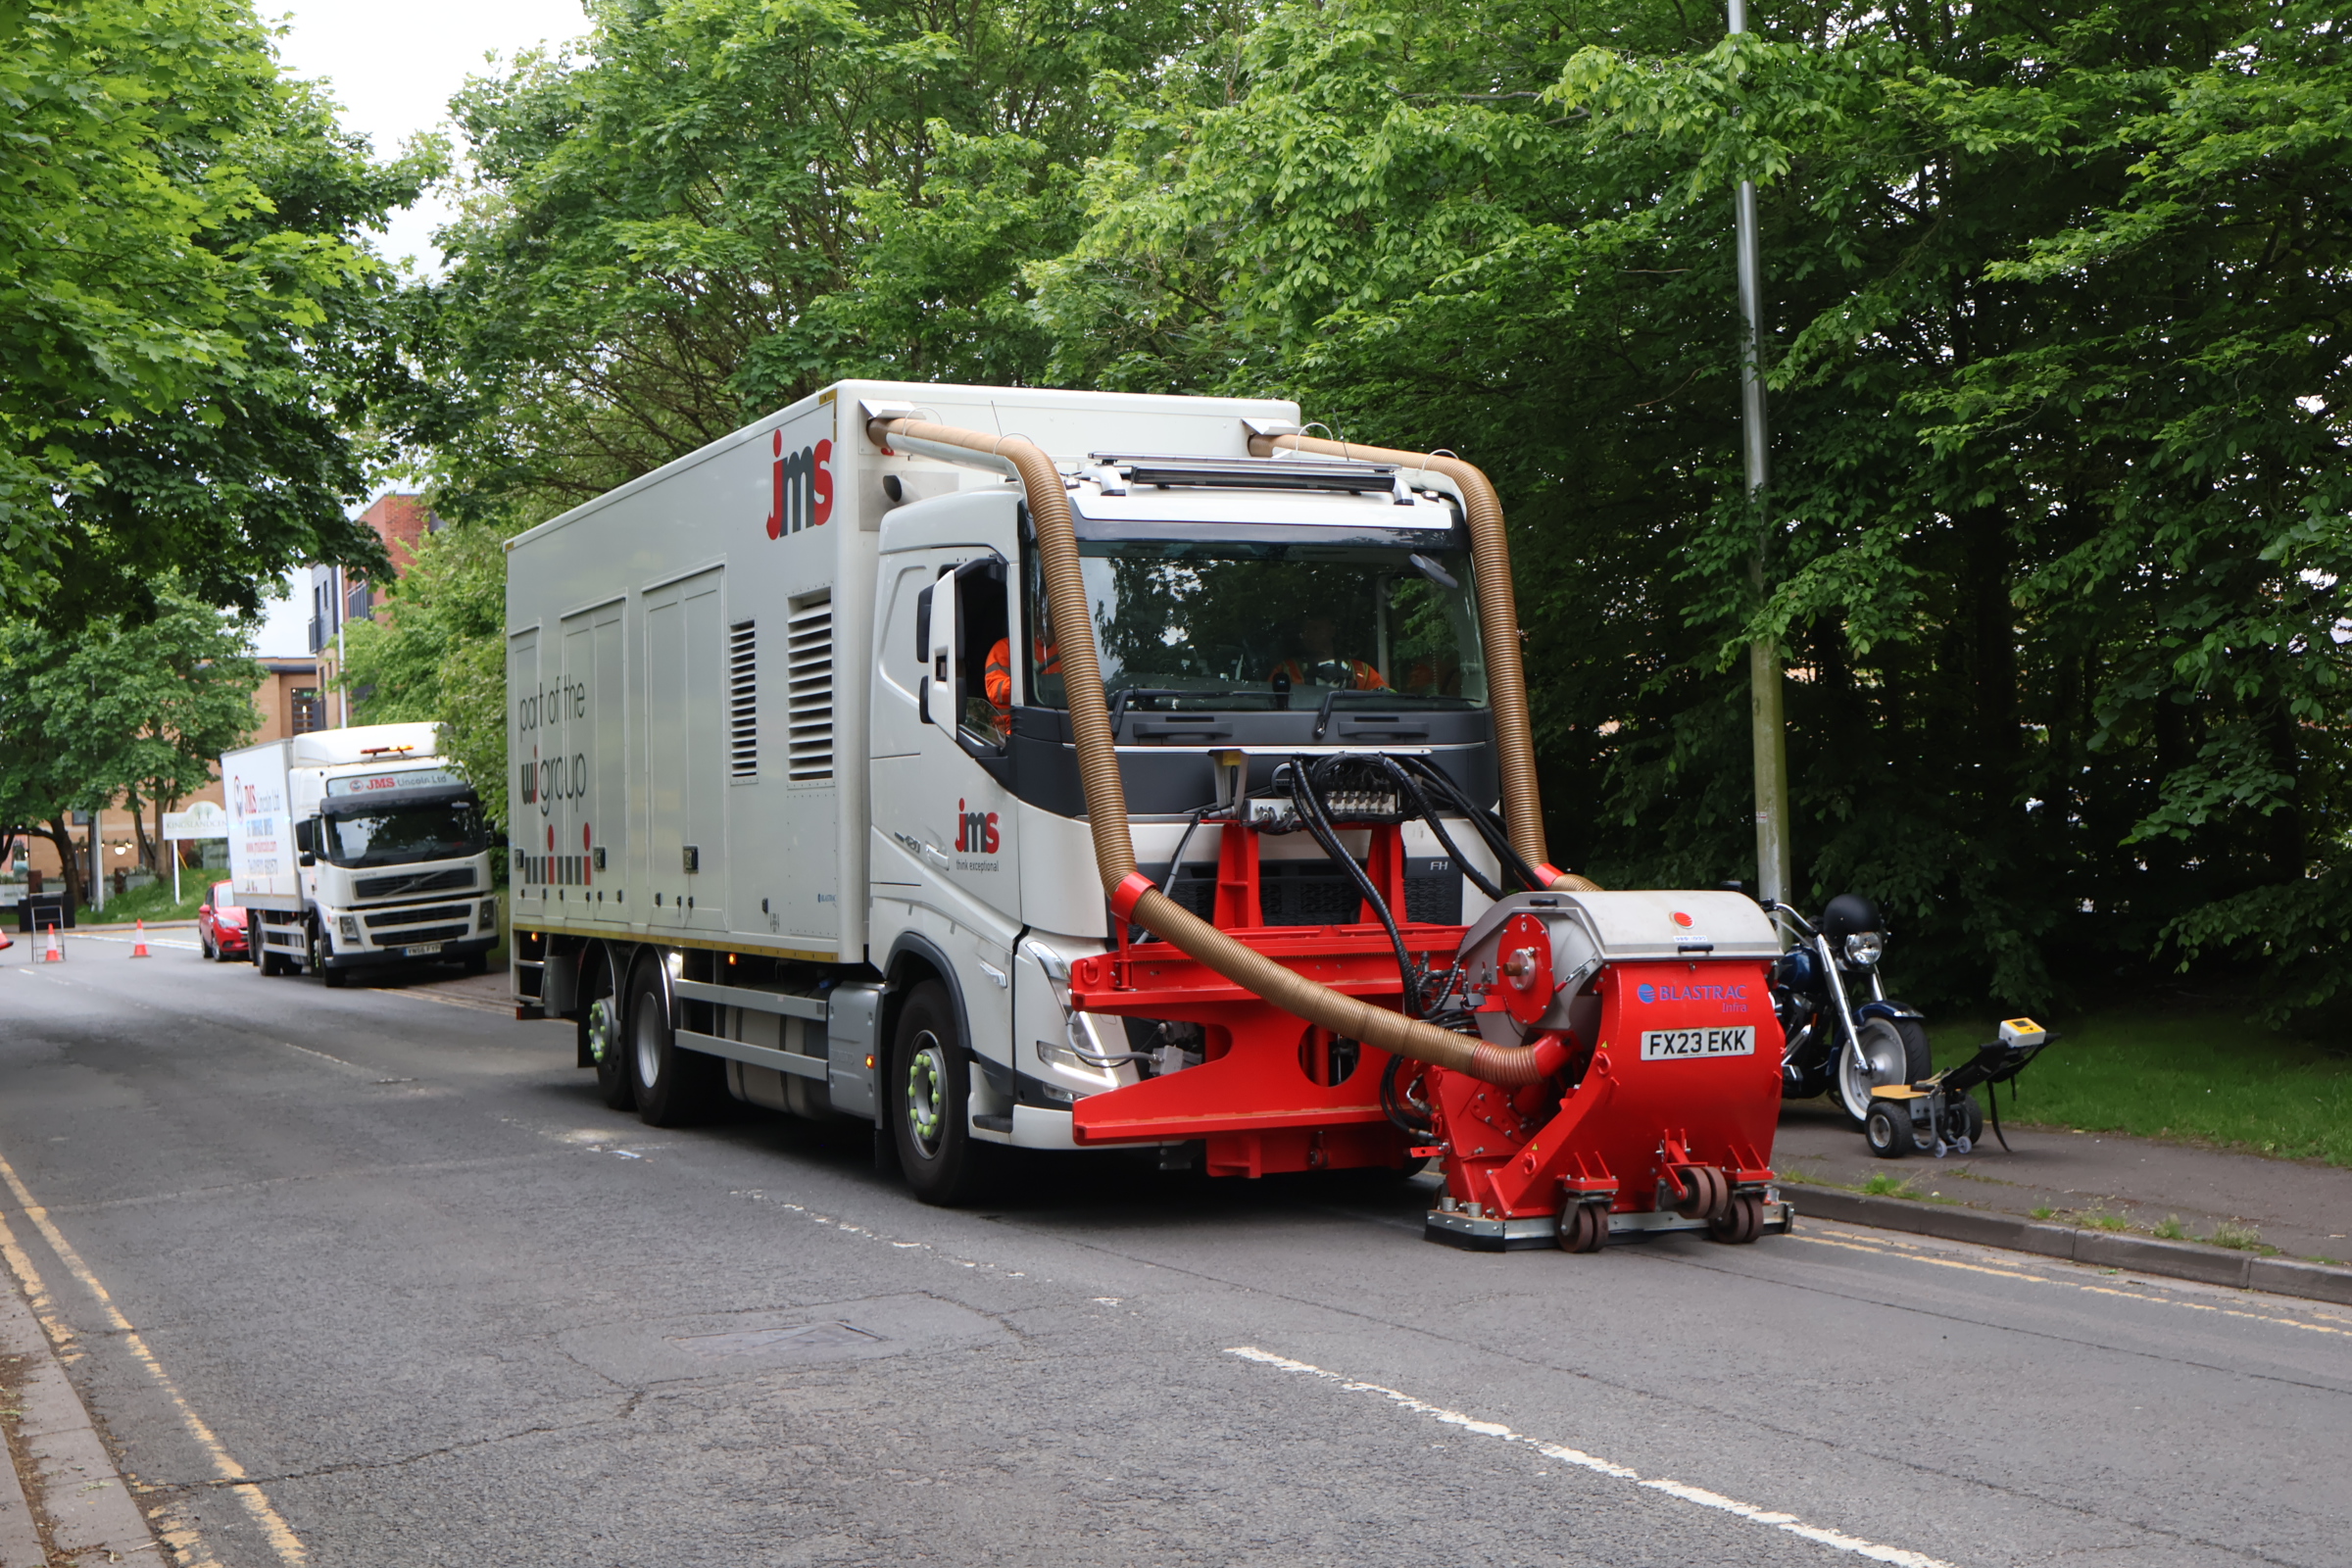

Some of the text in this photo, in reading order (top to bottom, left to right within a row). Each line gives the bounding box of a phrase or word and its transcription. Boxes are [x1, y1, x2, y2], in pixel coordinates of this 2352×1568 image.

[766, 428, 833, 540] jms
[519, 673, 585, 743] part of the
[367, 774, 447, 790] JMS Lincoln Ltd
[955, 797, 1000, 854] jms
[956, 859, 1000, 873] think exceptional
[1430, 860, 1448, 870] FH
[1659, 985, 1747, 1001] BLASTRAC
[1722, 1003, 1747, 1013] Infra
[1649, 1030, 1746, 1055] FX23 EKK
